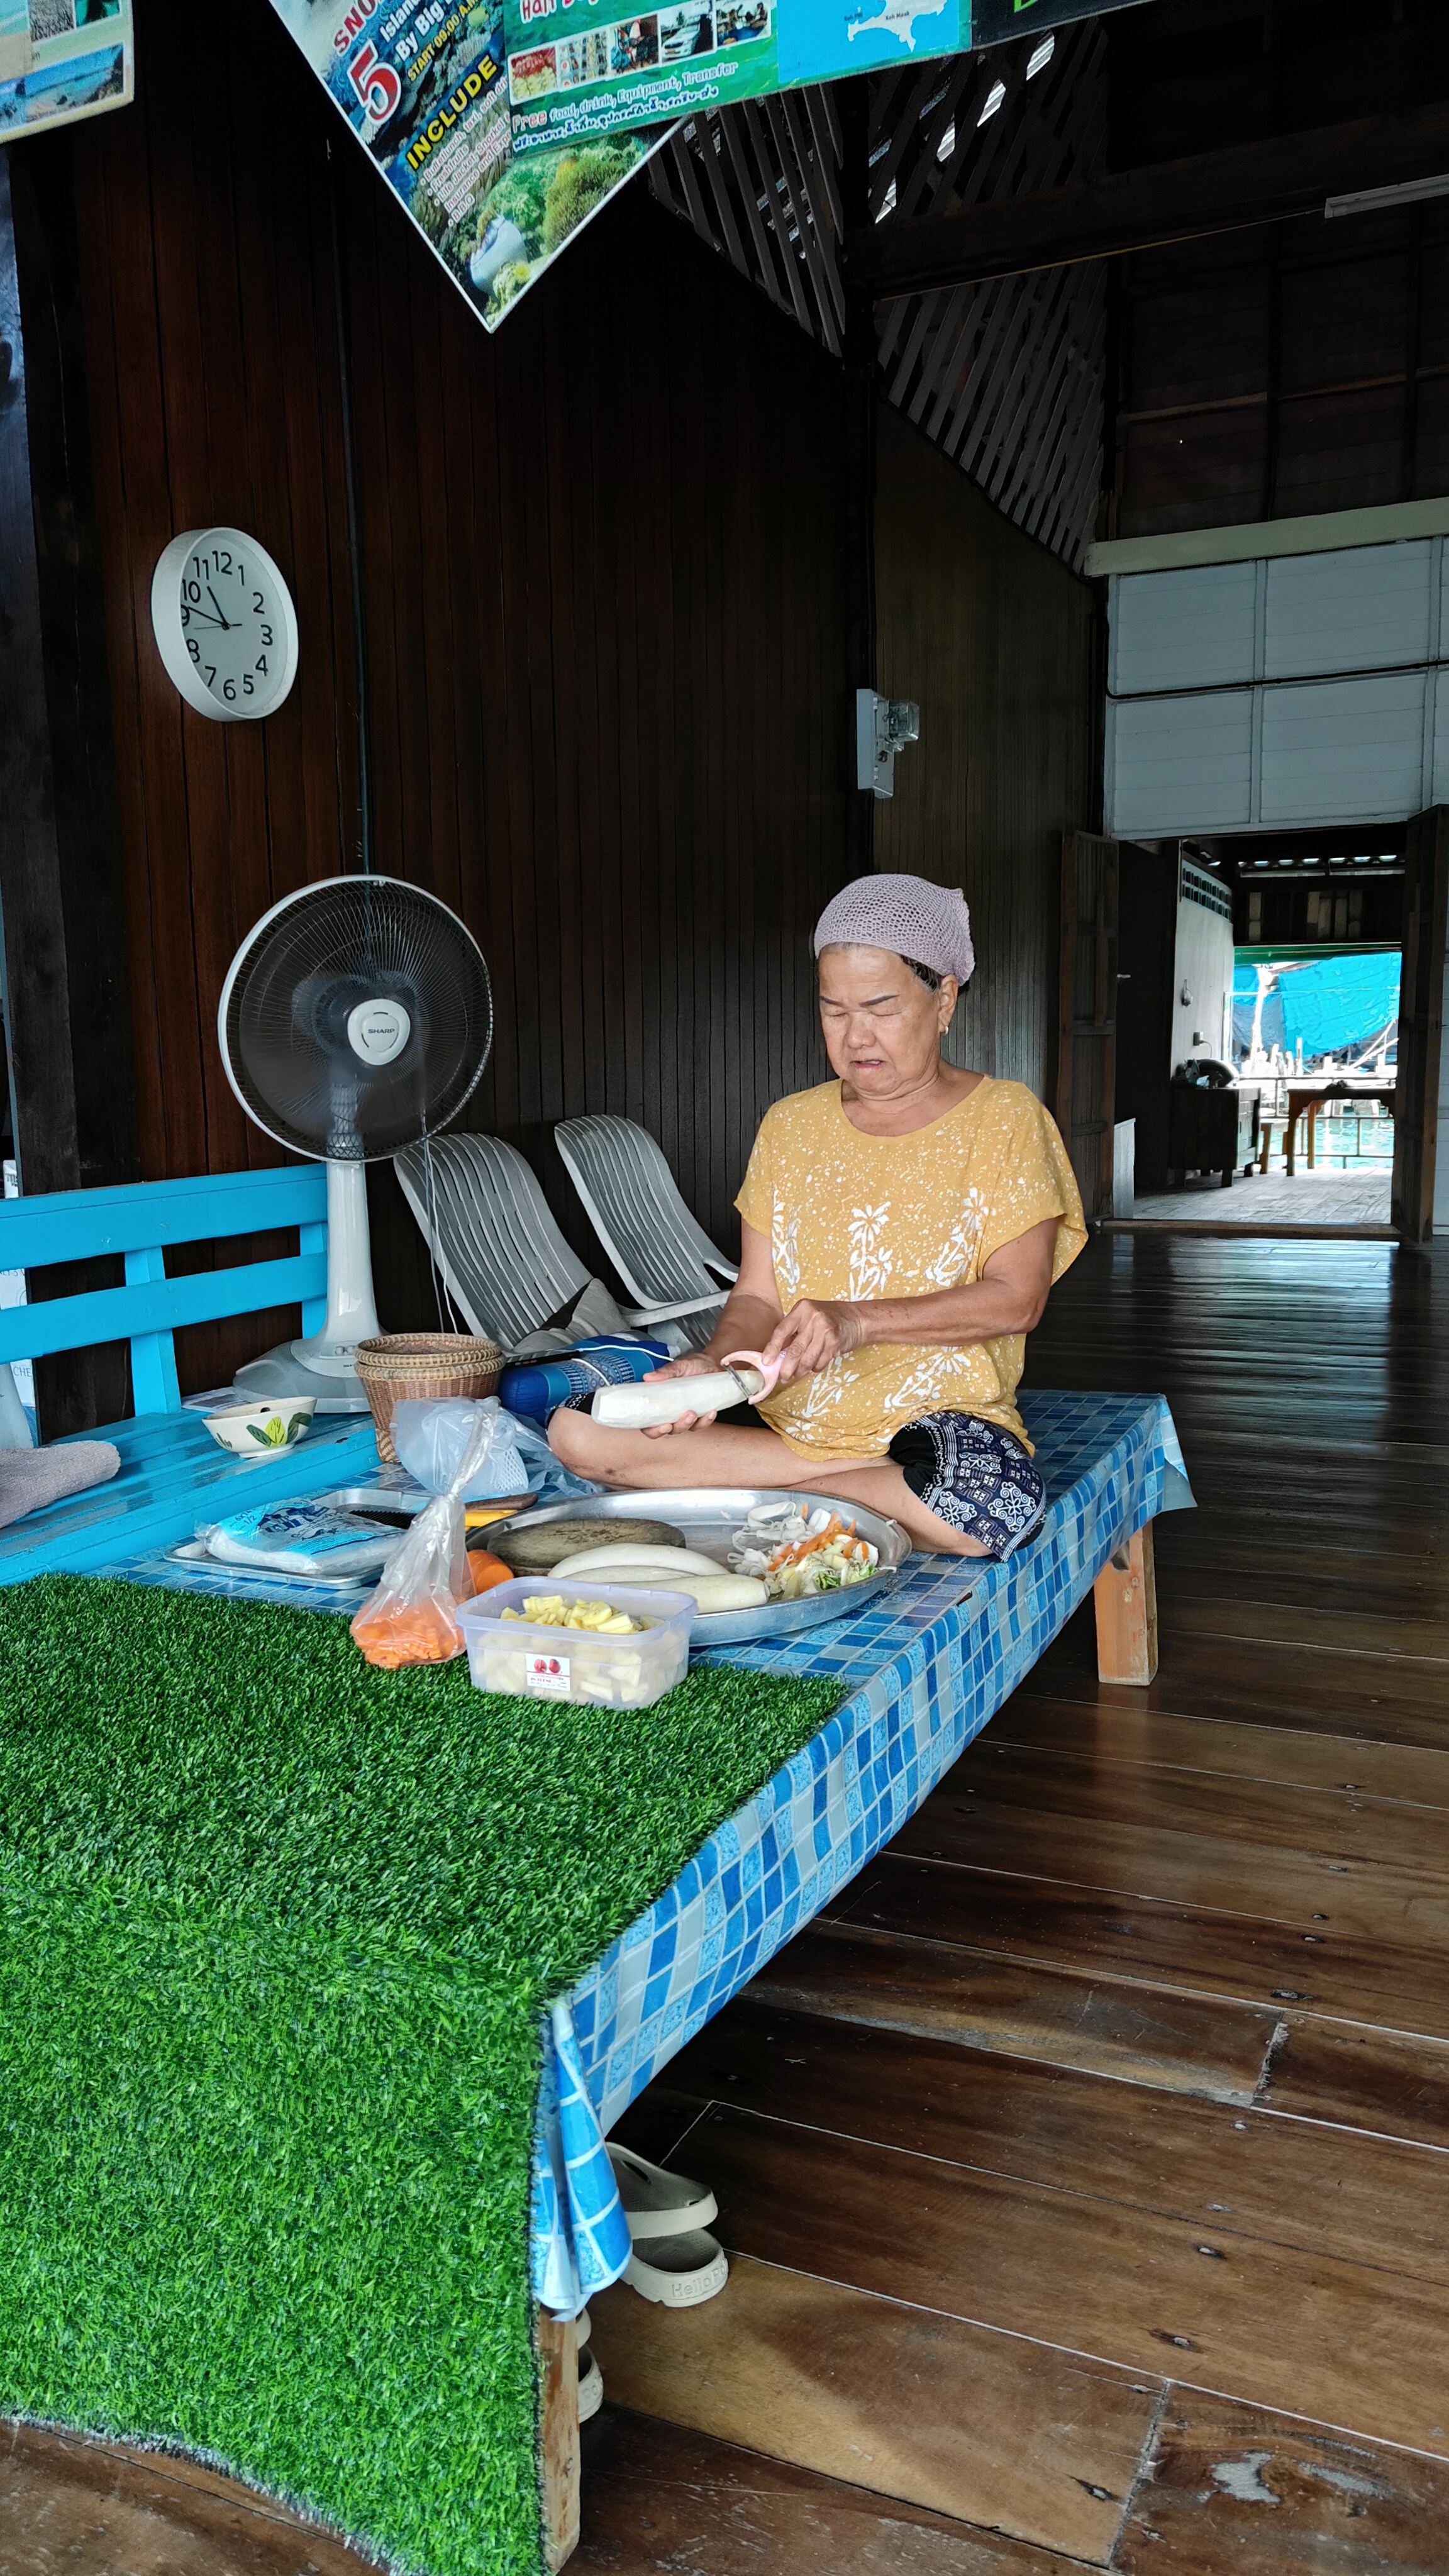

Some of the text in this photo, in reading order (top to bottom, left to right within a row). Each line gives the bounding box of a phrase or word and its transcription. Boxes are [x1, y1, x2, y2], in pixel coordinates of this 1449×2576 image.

[380, 0, 421, 42] Islan
[395, 1, 445, 61] By Big
[408, 43, 435, 81] START
[434, 13, 460, 48] 09.00
[348, 40, 401, 124] 5
[480, 90, 497, 112] soft
[512, 111, 548, 134] Free
[681, 62, 738, 87] Transfer
[406, 54, 497, 170] INCLUDE
[438, 182, 454, 203] Life
[475, 118, 504, 155] Snorkel
[445, 170, 480, 213] Insurance
[479, 150, 494, 173] and
[192, 557, 209, 580] 11
[212, 550, 233, 575] 12
[238, 565, 245, 586] 1
[182, 579, 201, 603] 10
[252, 592, 265, 614] 2
[180, 604, 191, 627] 9
[260, 624, 273, 646] 3
[187, 639, 200, 663] 8
[204, 665, 217, 687] 7
[255, 654, 269, 677] 4
[223, 679, 236, 701] 6
[243, 674, 255, 695] 5
[244, 1515, 257, 1526] 1/2
